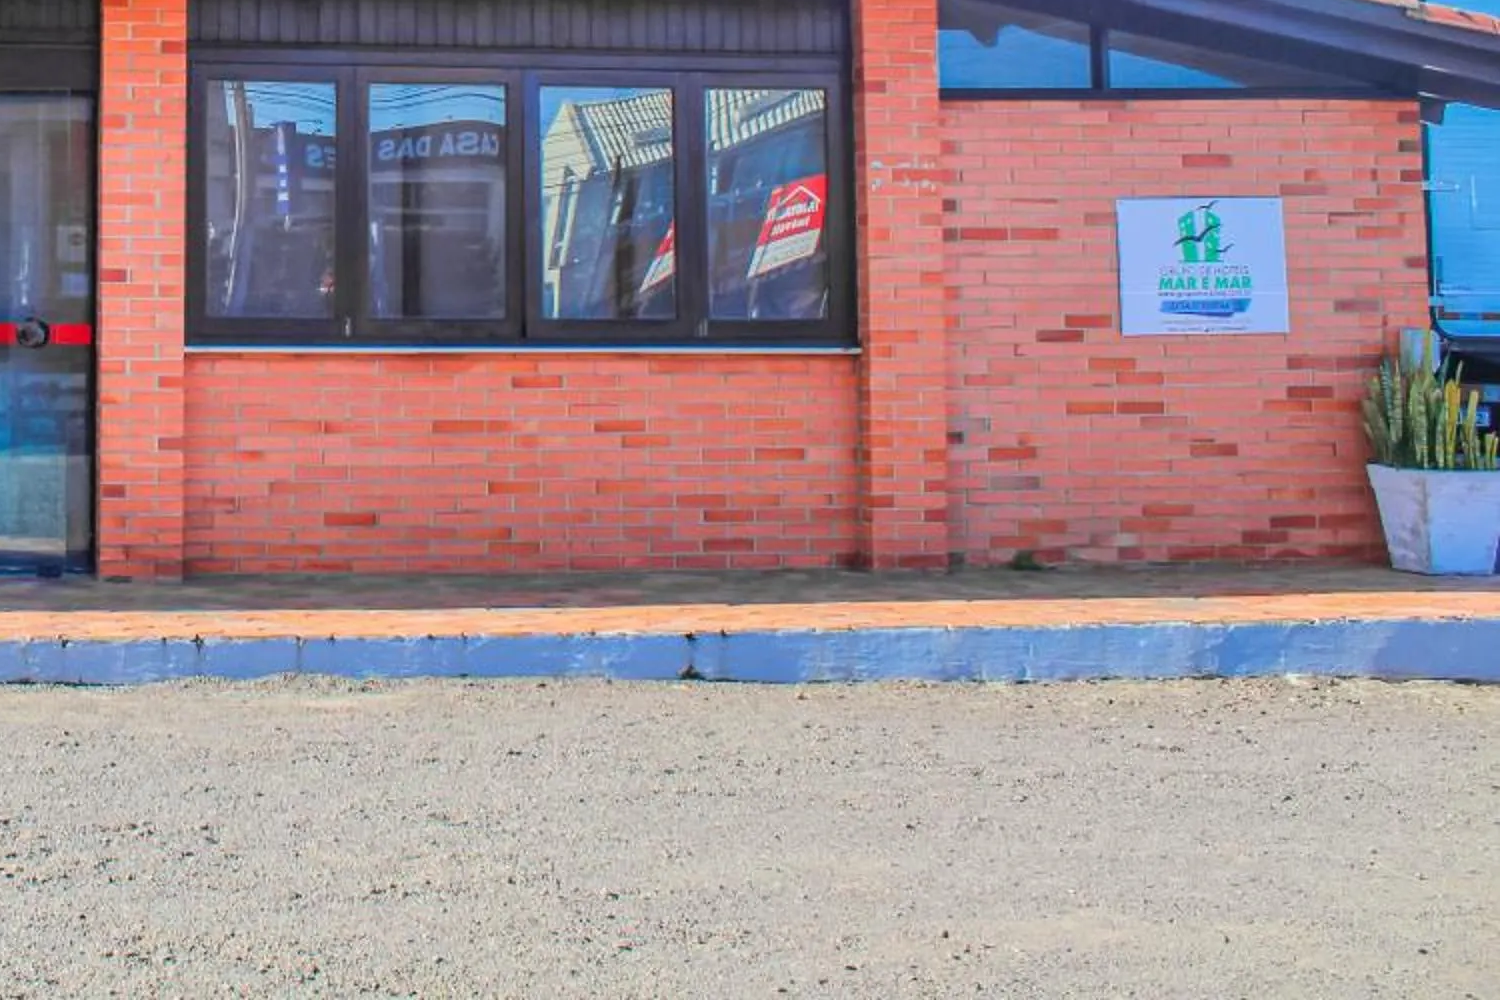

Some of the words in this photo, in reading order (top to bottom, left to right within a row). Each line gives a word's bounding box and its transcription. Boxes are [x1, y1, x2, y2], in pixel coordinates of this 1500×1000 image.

[1158, 276, 1197, 290] MAR
[1202, 276, 1210, 290] E
[1214, 275, 1253, 290] MAR
